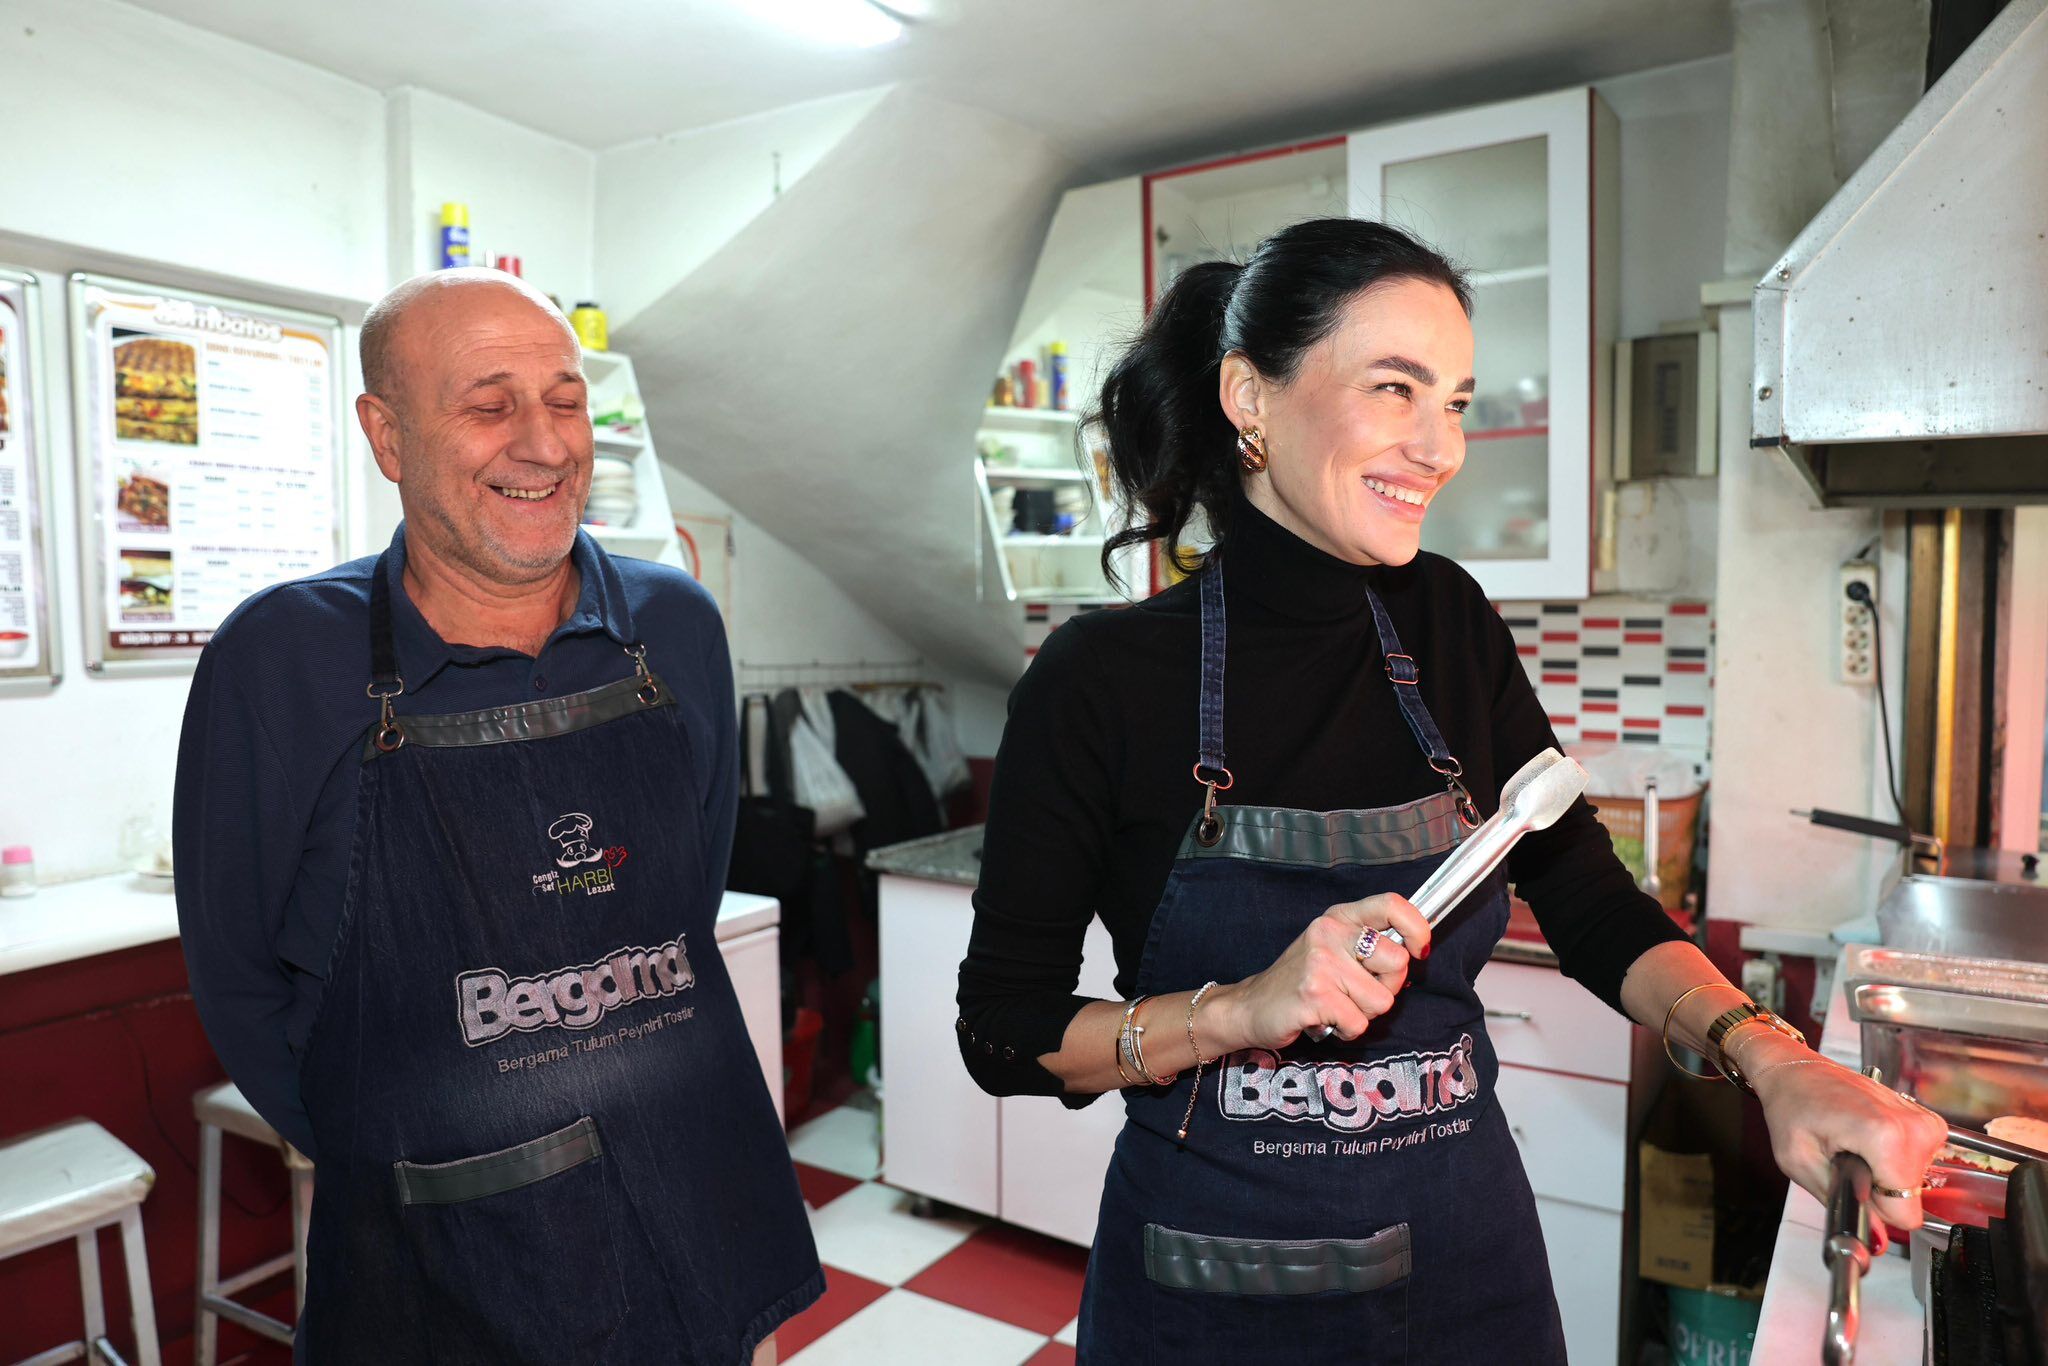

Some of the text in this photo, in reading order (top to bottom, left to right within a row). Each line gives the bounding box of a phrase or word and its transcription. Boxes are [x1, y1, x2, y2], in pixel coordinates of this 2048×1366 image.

[461, 938, 693, 1042] Bergama
[498, 1043, 569, 1073] Bergama
[572, 1031, 617, 1056] Tulum
[1222, 1036, 1477, 1130] Bergama
[1253, 1140, 1327, 1158] Bergama
[1424, 1117, 1473, 1139] Tostlar
